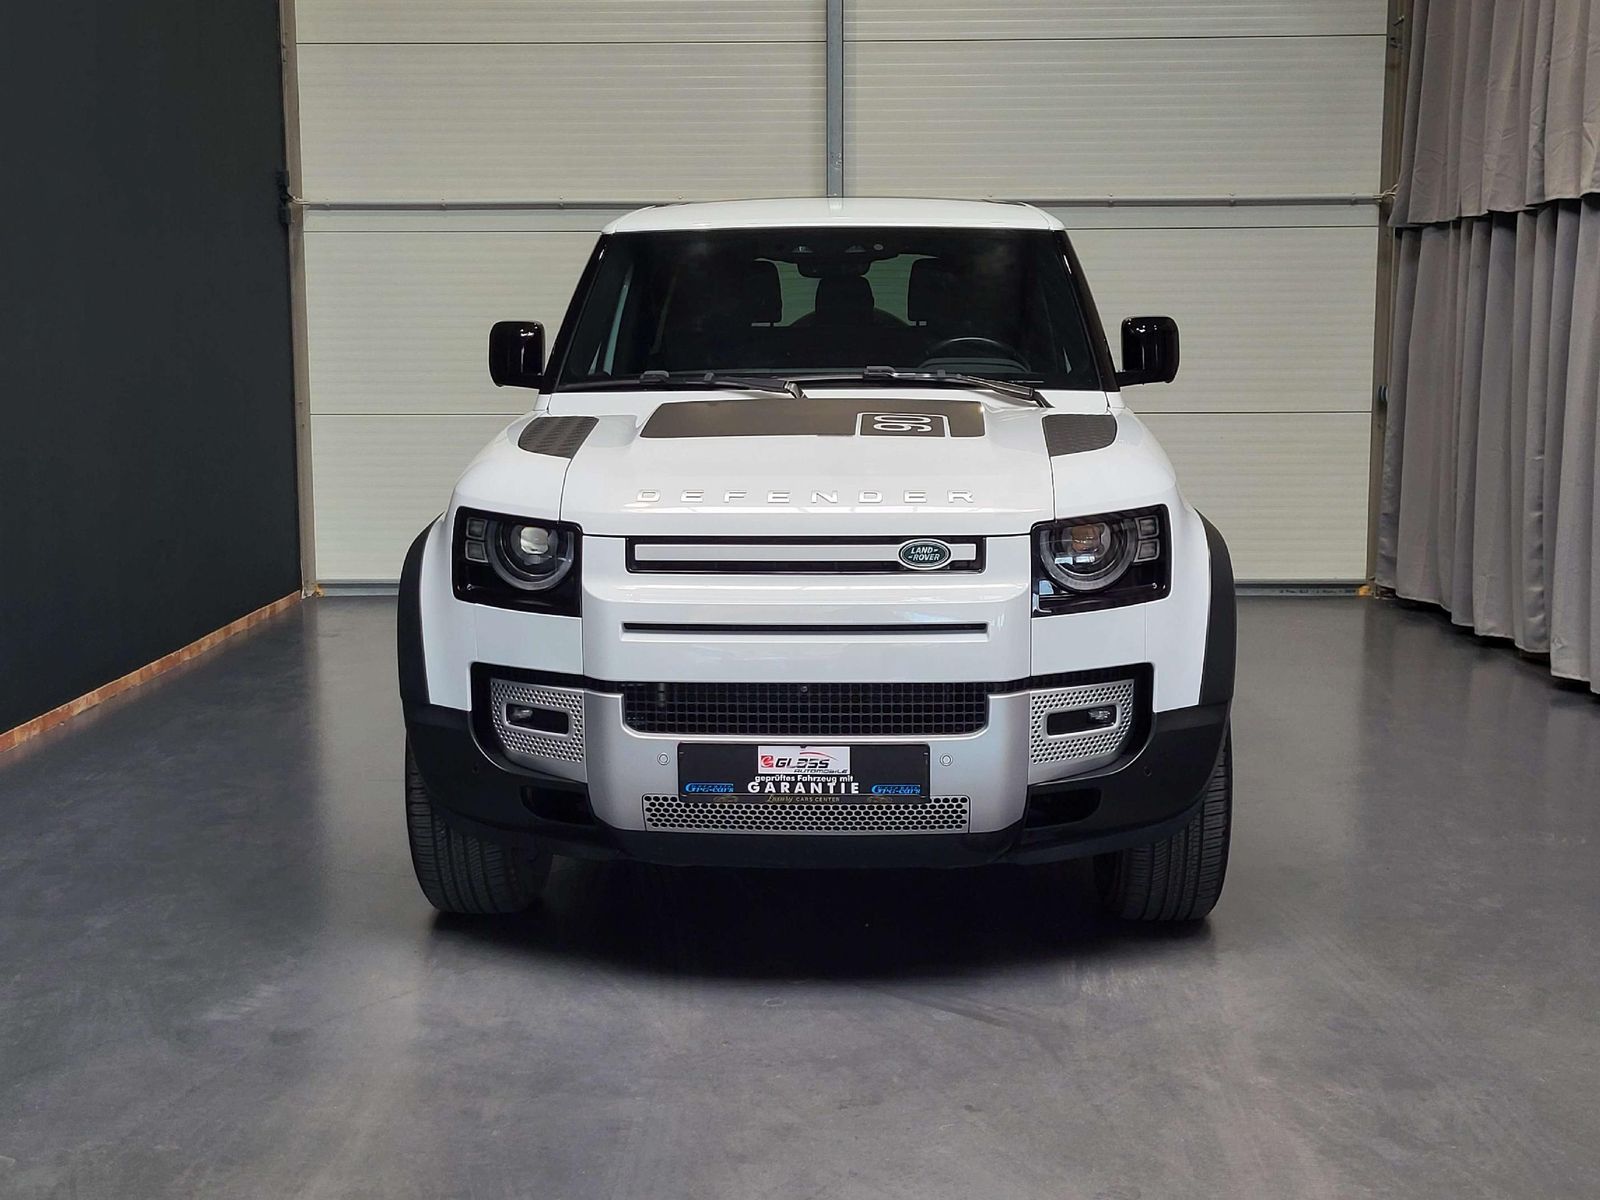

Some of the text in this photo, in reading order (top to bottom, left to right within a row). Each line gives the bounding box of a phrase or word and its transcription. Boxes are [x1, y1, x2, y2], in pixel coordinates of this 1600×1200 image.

[636, 489, 974, 503] DEFENDER
[911, 546, 933, 554] LAND
[912, 553, 940, 561] ROVER
[754, 774, 854, 784] geprüftes Fahrzeug mit
[747, 781, 859, 794] GARANTIE
